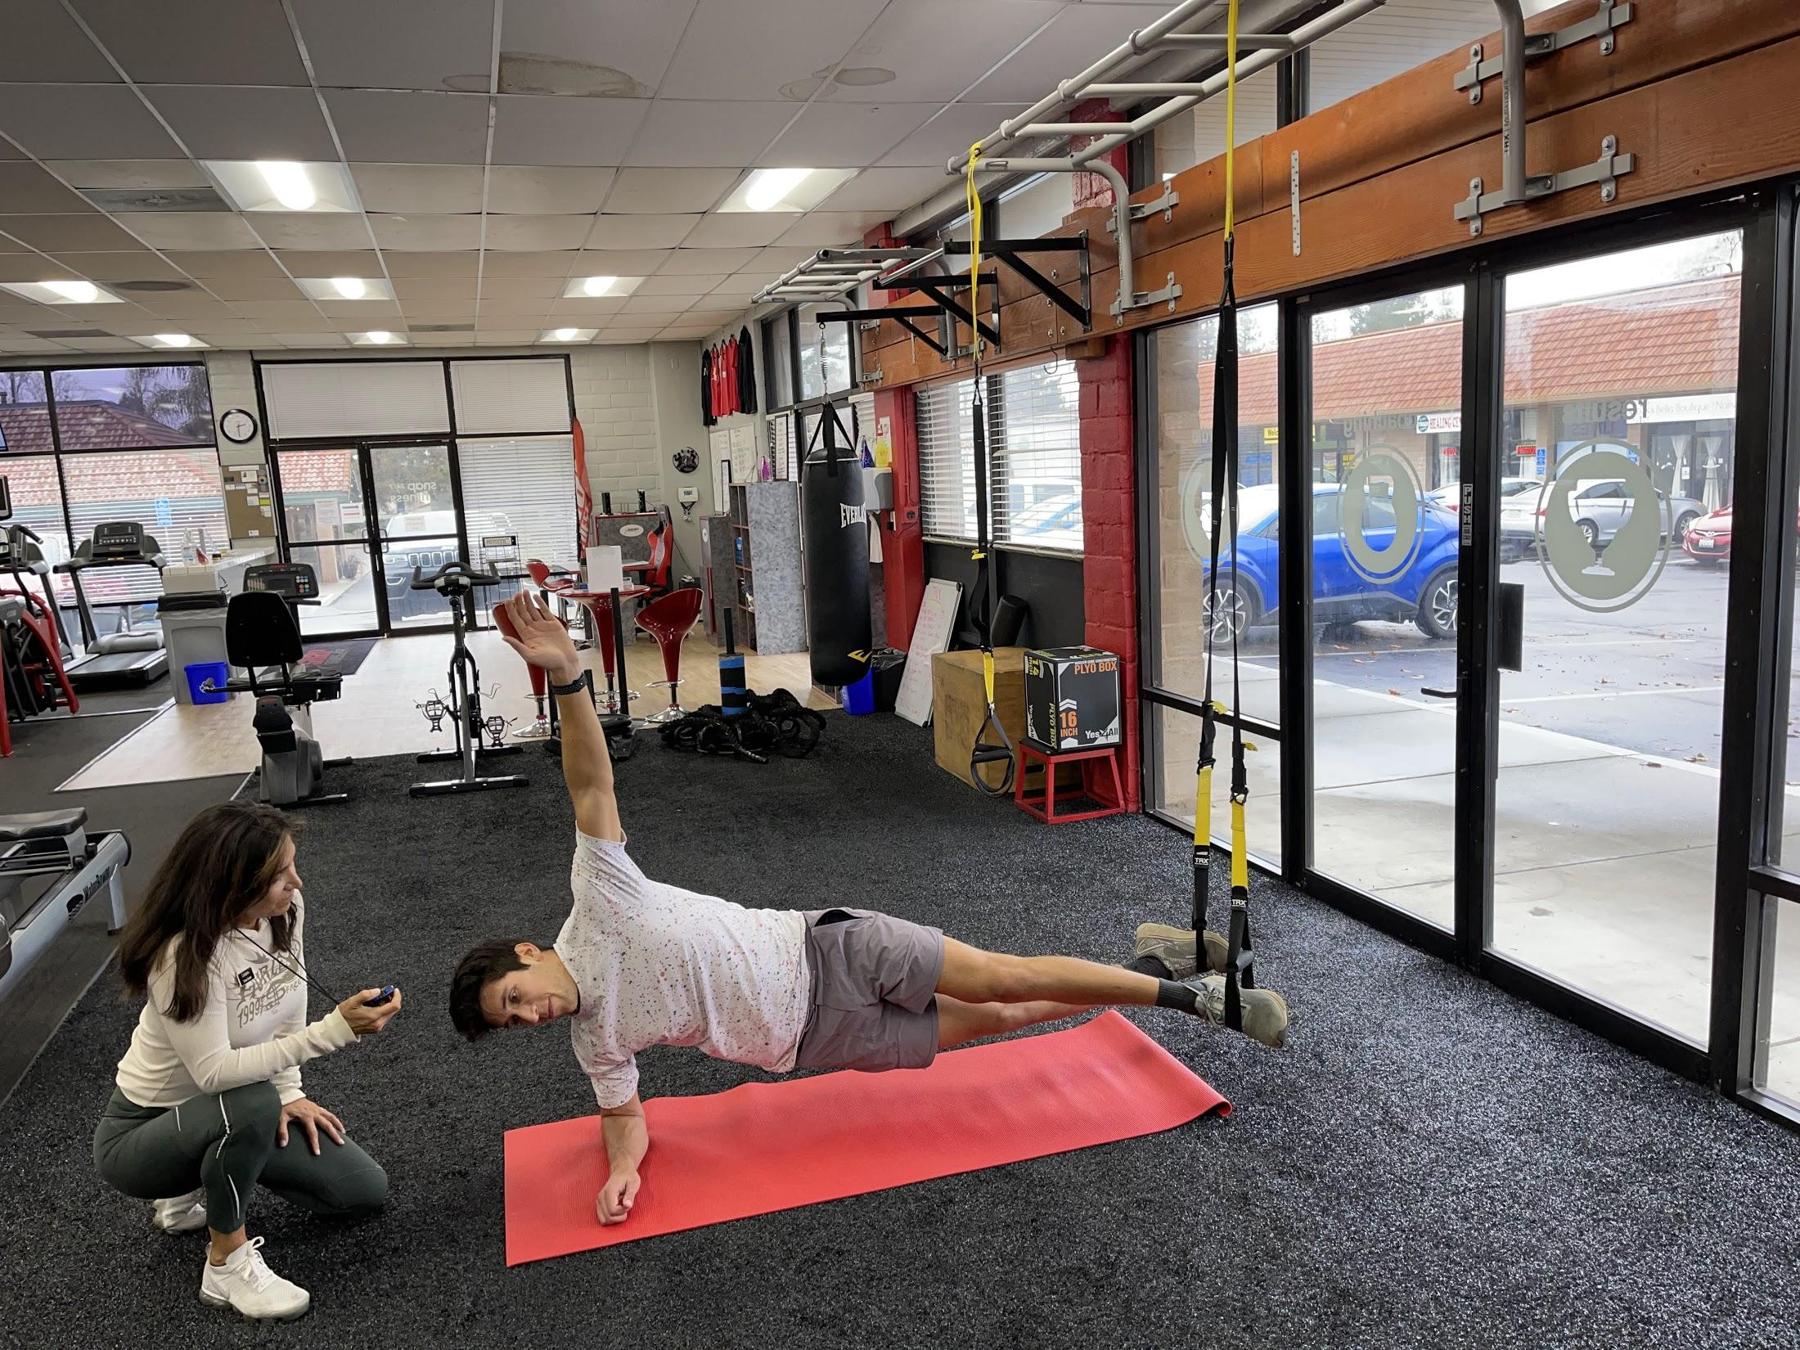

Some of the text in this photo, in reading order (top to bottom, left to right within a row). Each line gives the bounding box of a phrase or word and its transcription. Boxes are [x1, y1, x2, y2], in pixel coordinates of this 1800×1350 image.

[1464, 486, 1472, 524] PUSH
[1074, 662, 1097, 675] PLYO
[1098, 660, 1118, 673] BOX
[1059, 711, 1077, 728] 16
[1060, 727, 1078, 737] INCH
[1195, 857, 1209, 865] TRX
[1232, 898, 1247, 907] TRX
